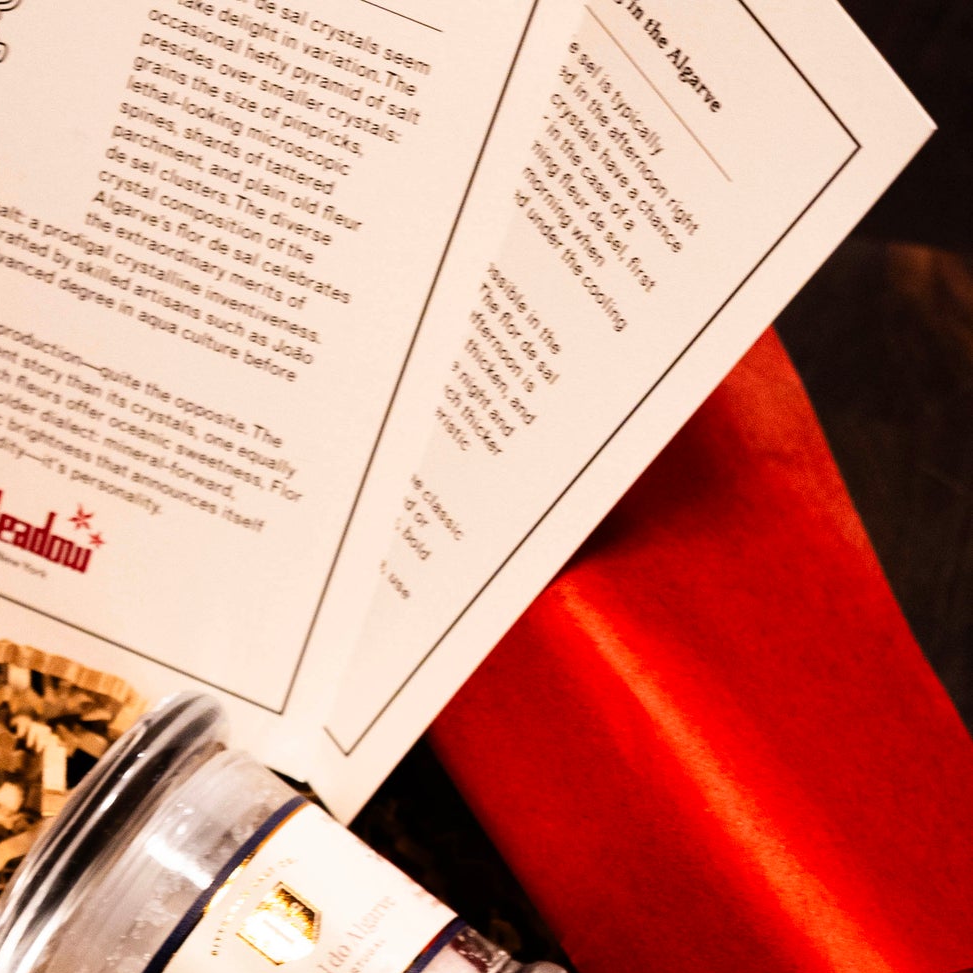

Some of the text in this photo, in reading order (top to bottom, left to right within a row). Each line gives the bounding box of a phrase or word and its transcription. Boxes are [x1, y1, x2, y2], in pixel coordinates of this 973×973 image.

[133, 55, 188, 85] grains
[190, 75, 220, 98] the
[221, 90, 258, 113] size
[260, 105, 282, 121] of
[140, 32, 214, 69] presides
[217, 63, 257, 85] over
[258, 79, 325, 112] smaller
[148, 9, 421, 125] occasional hefty pyramid of salt
[176, 0, 215, 16] ake
[217, 7, 278, 42] delight
[280, 30, 298, 49] in
[385, 69, 417, 97] The
[279, 6, 308, 26] sal
[309, 19, 379, 55] crystals
[382, 48, 430, 75] seem
[642, 17, 668, 49] the
[665, 47, 721, 113] Algarve
[126, 75, 350, 176] lethal-looking microscopic
[577, 52, 663, 155] sel is typically
[104, 145, 127, 164] de
[129, 157, 157, 175] sel
[234, 193, 266, 219] The
[269, 211, 332, 246] diverse
[182, 127, 241, 158] shards
[243, 151, 265, 166] of
[265, 157, 335, 195] tattered
[208, 163, 243, 184] and
[243, 177, 287, 202] plain
[290, 196, 319, 215] old
[321, 204, 362, 231] fleur
[545, 120, 635, 232] in the case of a
[550, 93, 599, 152] crystals
[597, 147, 629, 188] have
[626, 187, 639, 201] a
[637, 199, 682, 253] chance
[572, 81, 699, 236] in the afternoon right
[84, 211, 307, 310] the extraordinary merits of
[91, 190, 350, 304] Algarve's flor de sal celebrates
[98, 169, 315, 264] crystal composition of the
[558, 172, 590, 209] fleur
[586, 210, 605, 231] de
[625, 256, 656, 292] first
[570, 225, 605, 267] when
[51, 247, 72, 269] by
[75, 260, 131, 290] skilled
[132, 284, 201, 320] artisans
[204, 313, 245, 336] such
[247, 330, 268, 347] as
[526, 207, 627, 332] under the cooling
[497, 311, 523, 339] flor
[519, 340, 537, 361] de
[535, 360, 560, 385] sal
[524, 309, 541, 330] in
[538, 327, 561, 355] the
[457, 371, 516, 437] night and
[459, 405, 502, 455] thicker
[508, 396, 537, 425] and
[520, 373, 535, 393] is
[328, 944, 352, 968] do
